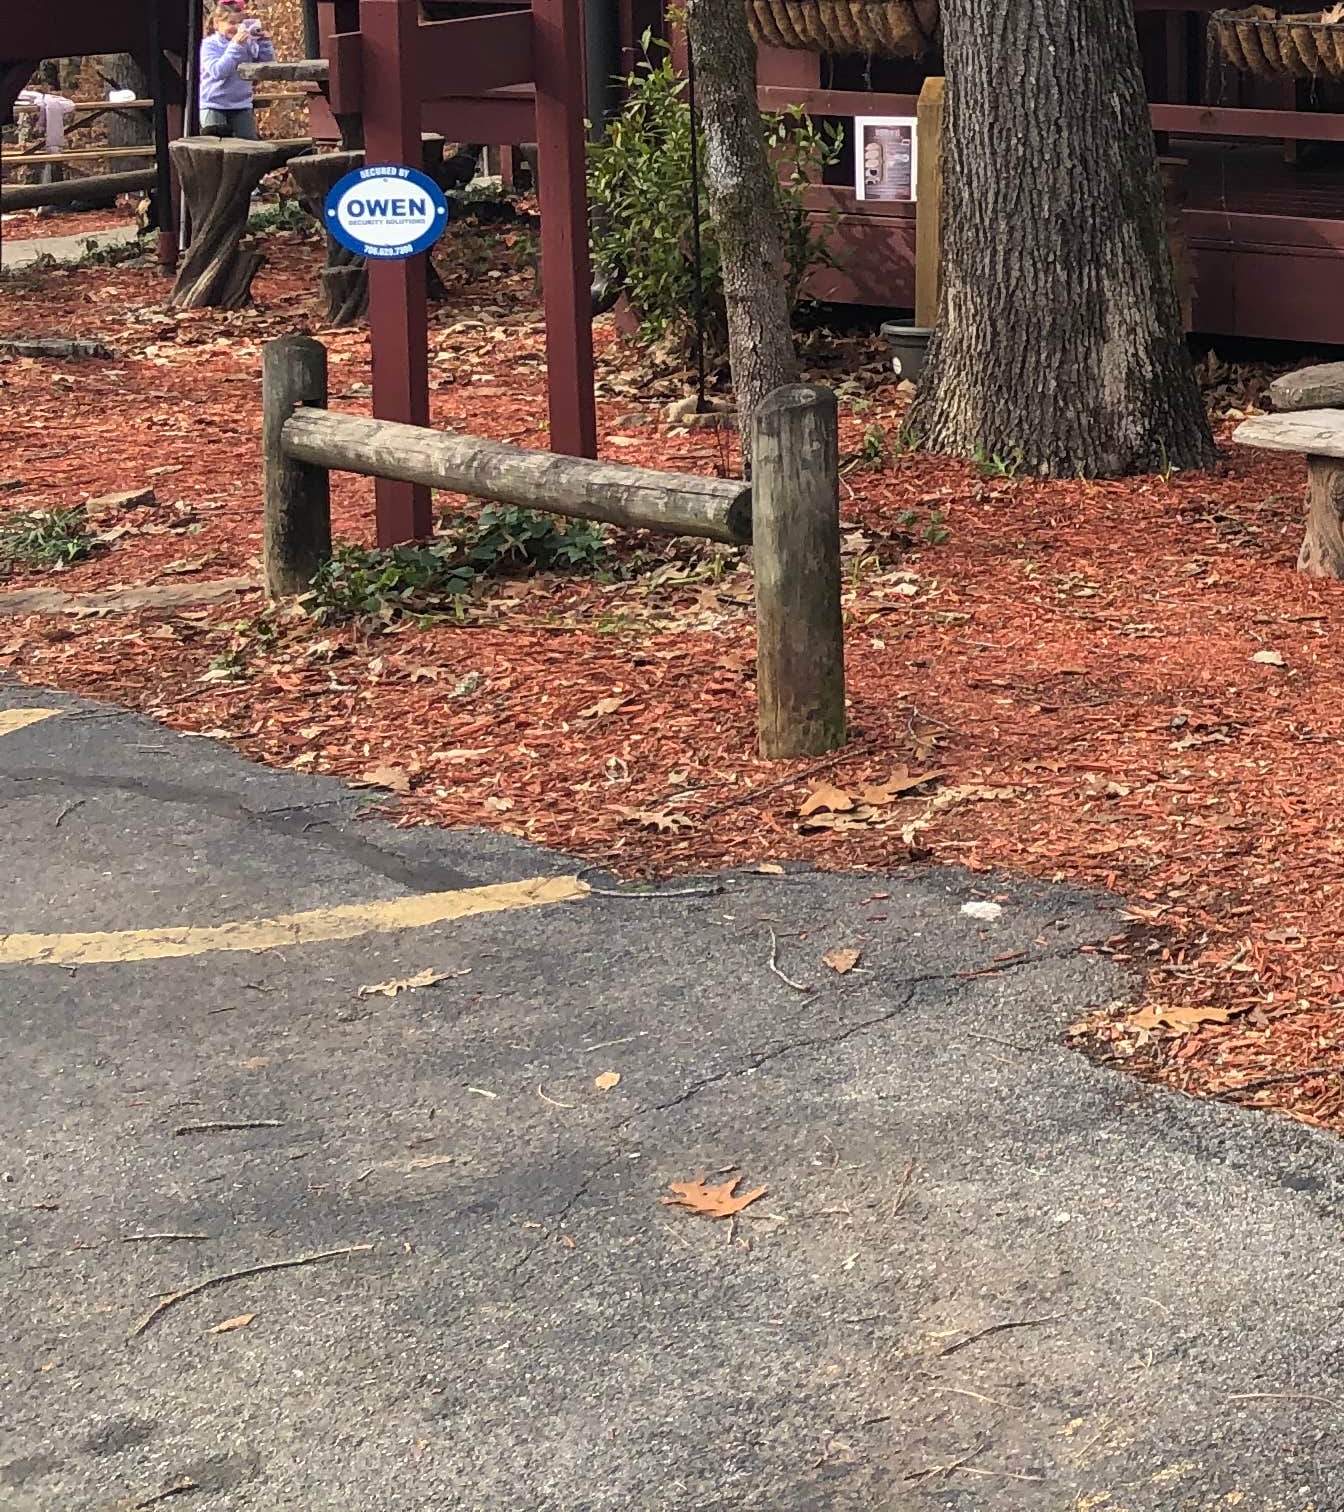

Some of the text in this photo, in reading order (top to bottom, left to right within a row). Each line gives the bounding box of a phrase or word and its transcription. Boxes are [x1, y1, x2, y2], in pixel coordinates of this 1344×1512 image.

[360, 167, 410, 179] SECURED BY
[347, 198, 426, 217] OWEN
